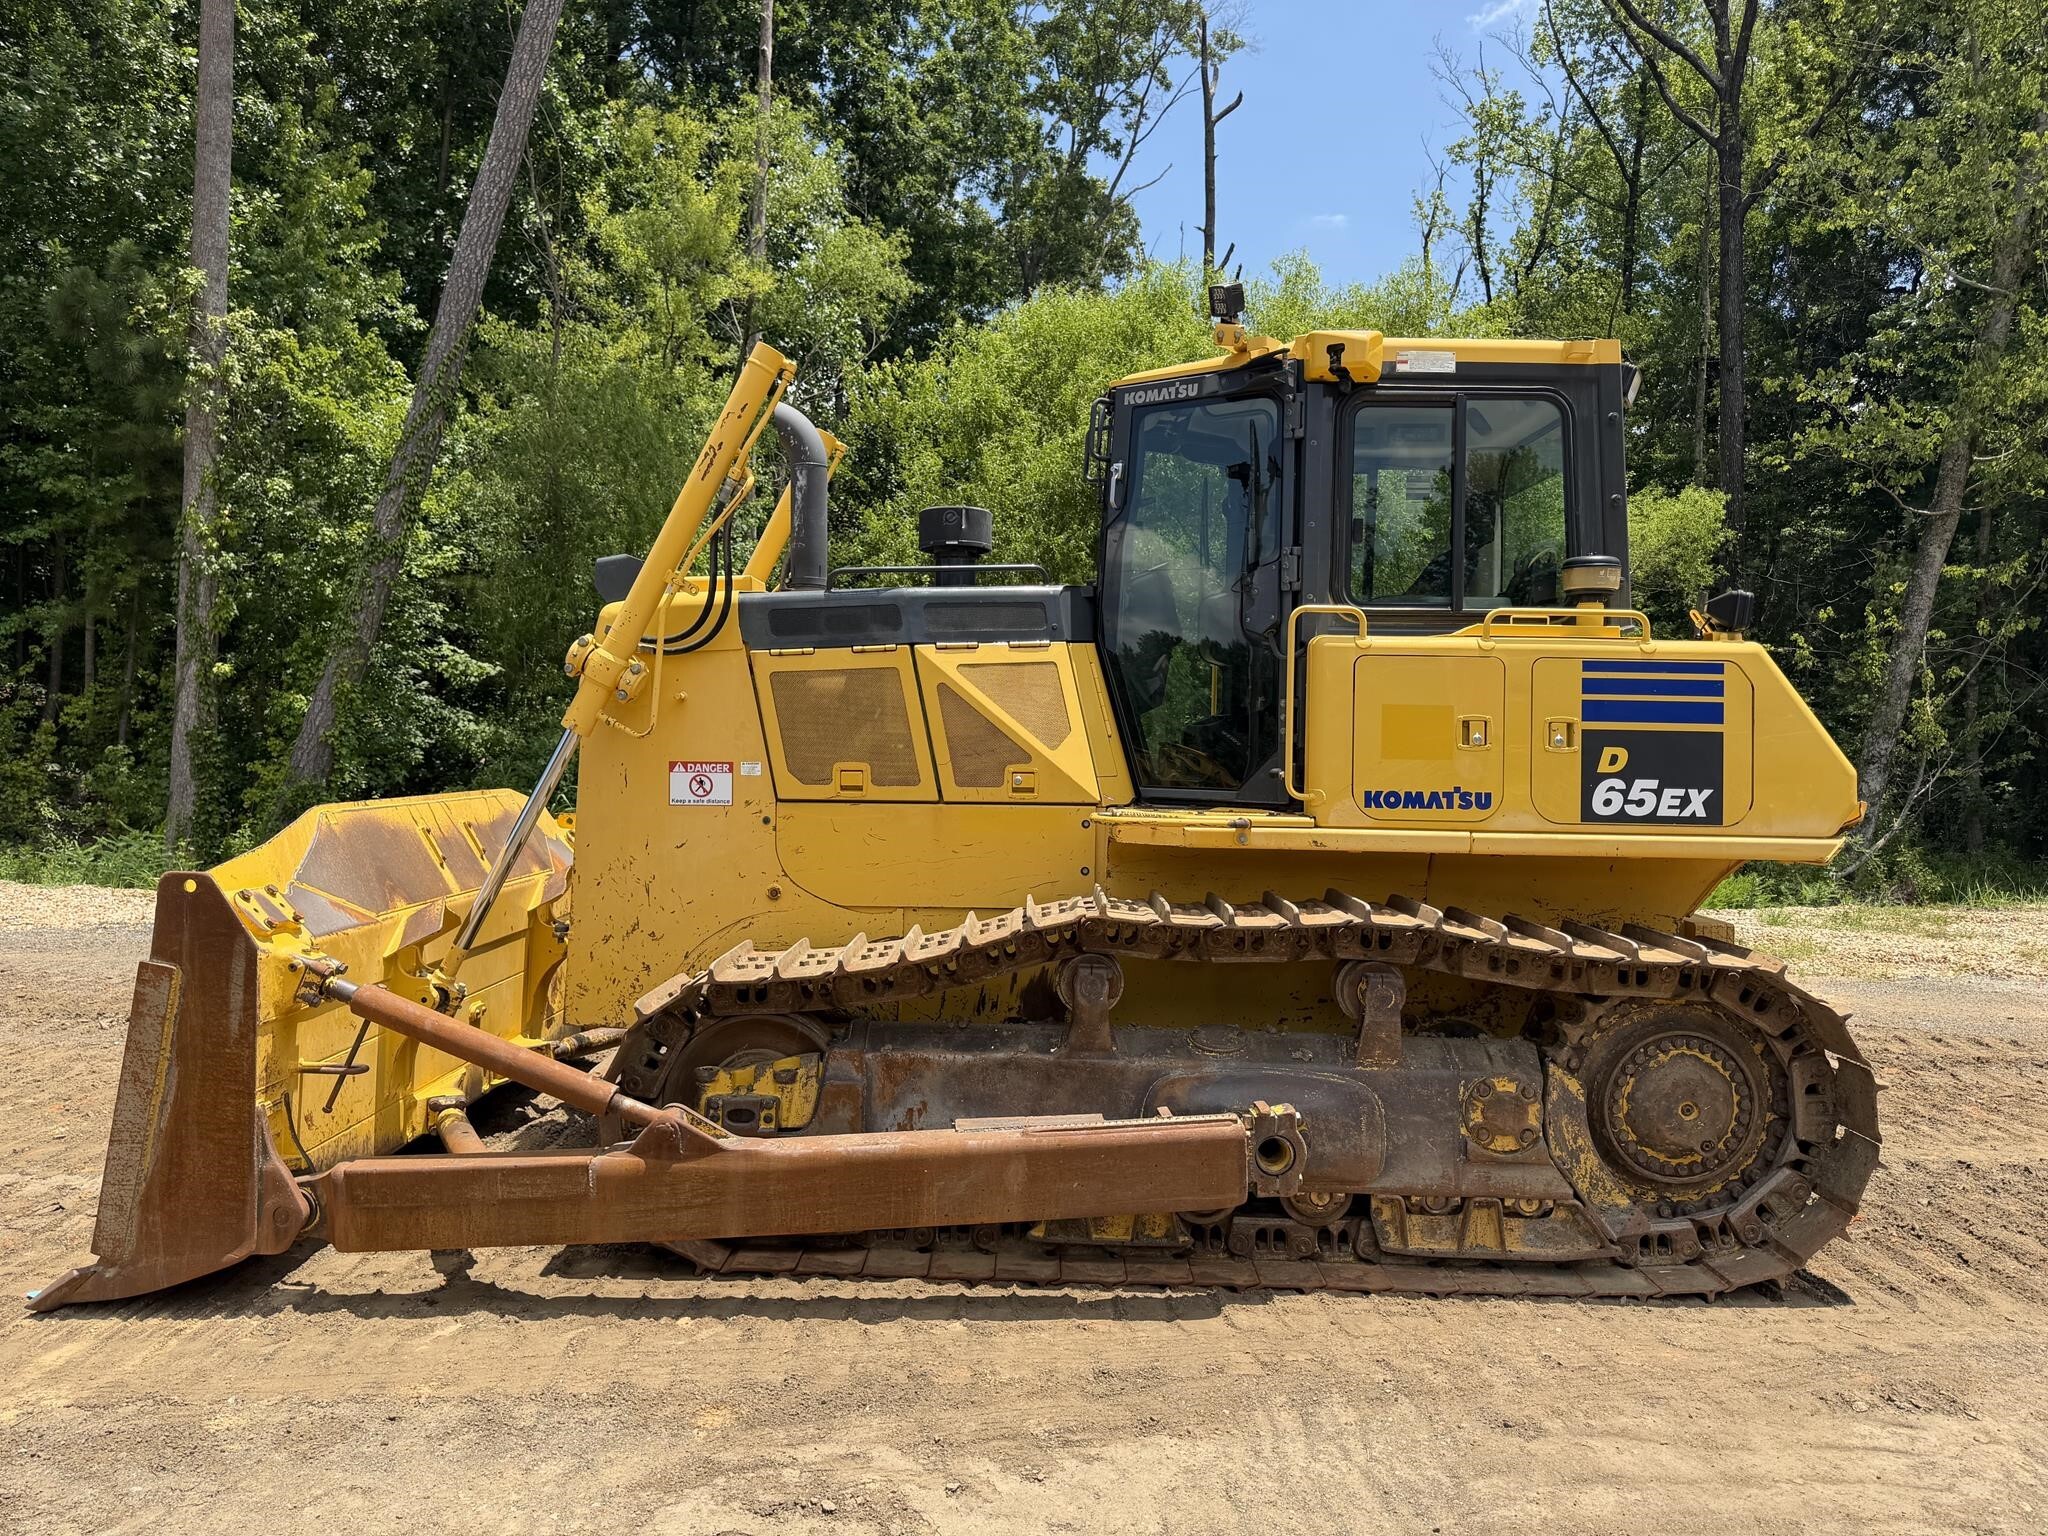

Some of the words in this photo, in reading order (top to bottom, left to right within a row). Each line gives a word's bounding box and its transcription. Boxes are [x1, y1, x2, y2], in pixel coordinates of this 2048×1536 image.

[1124, 381, 1199, 406] KOMATSU
[687, 763, 730, 773] DANGER
[1597, 747, 1629, 773] D
[1364, 786, 1492, 811] KOMATSU
[1592, 778, 1714, 818] 65EX
